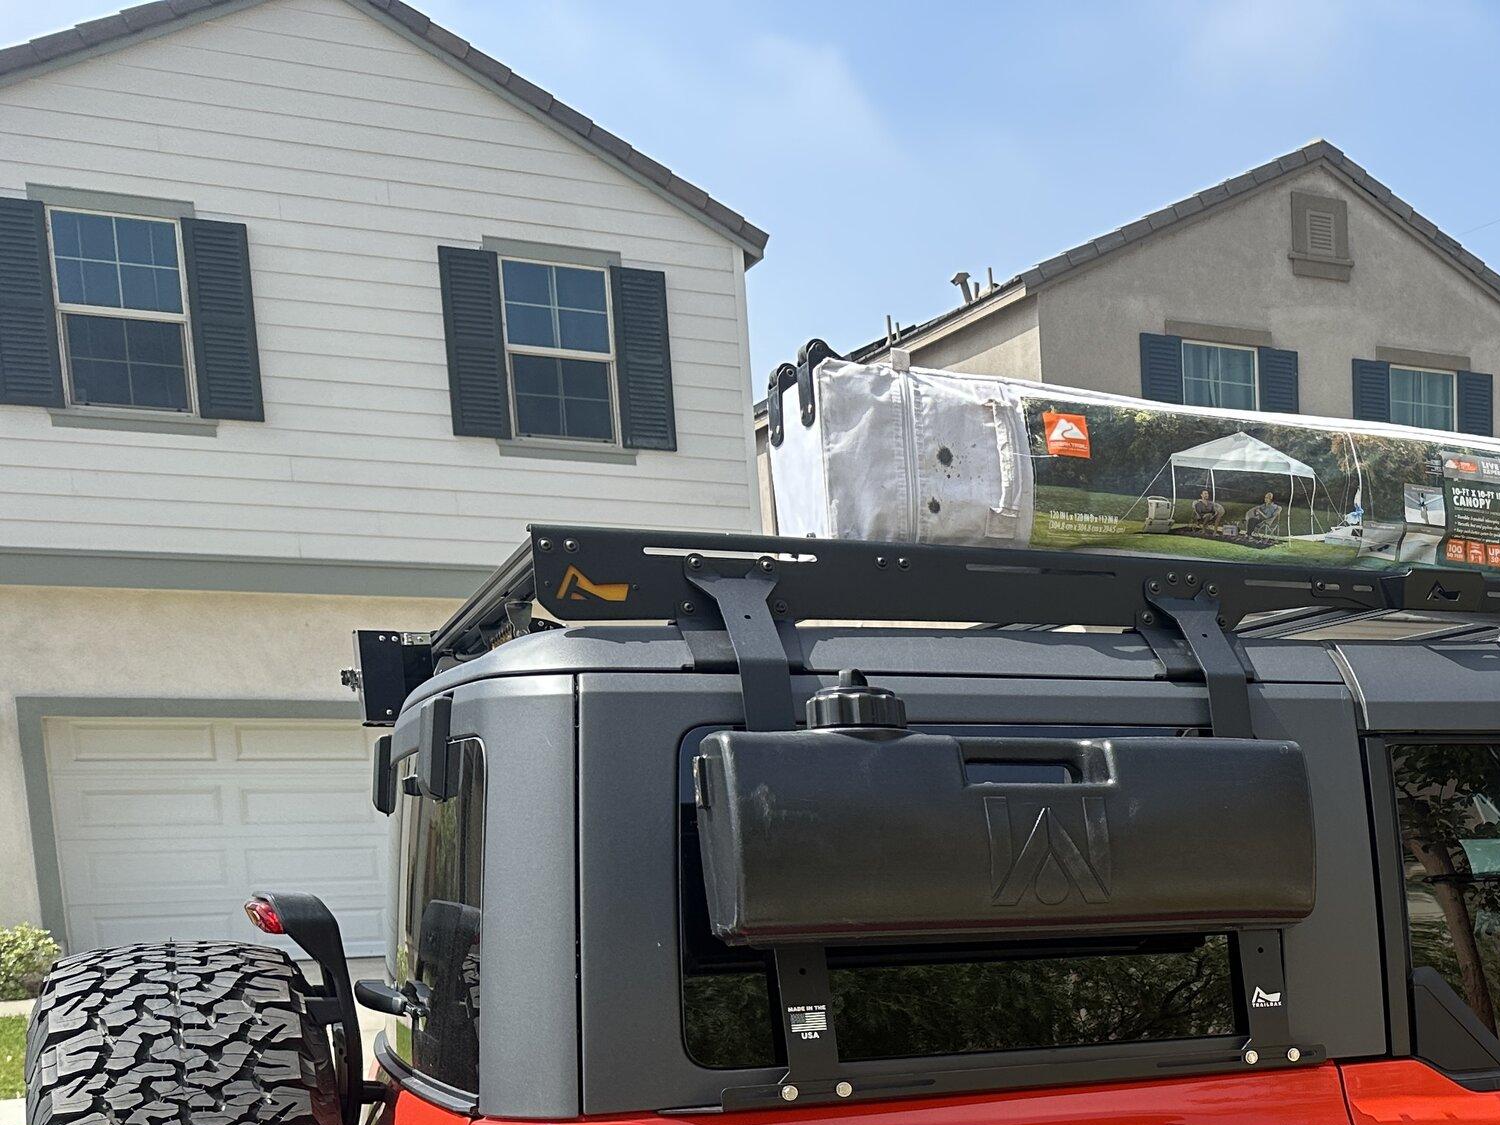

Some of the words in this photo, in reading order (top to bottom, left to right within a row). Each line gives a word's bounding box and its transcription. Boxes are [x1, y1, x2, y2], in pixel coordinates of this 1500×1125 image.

[1452, 487, 1469, 497] 10-FT
[1477, 490, 1495, 500] 10-FT
[1453, 495, 1491, 509] CANOPY
[1448, 544, 1462, 553] 100
[801, 1031, 820, 1039] USA
